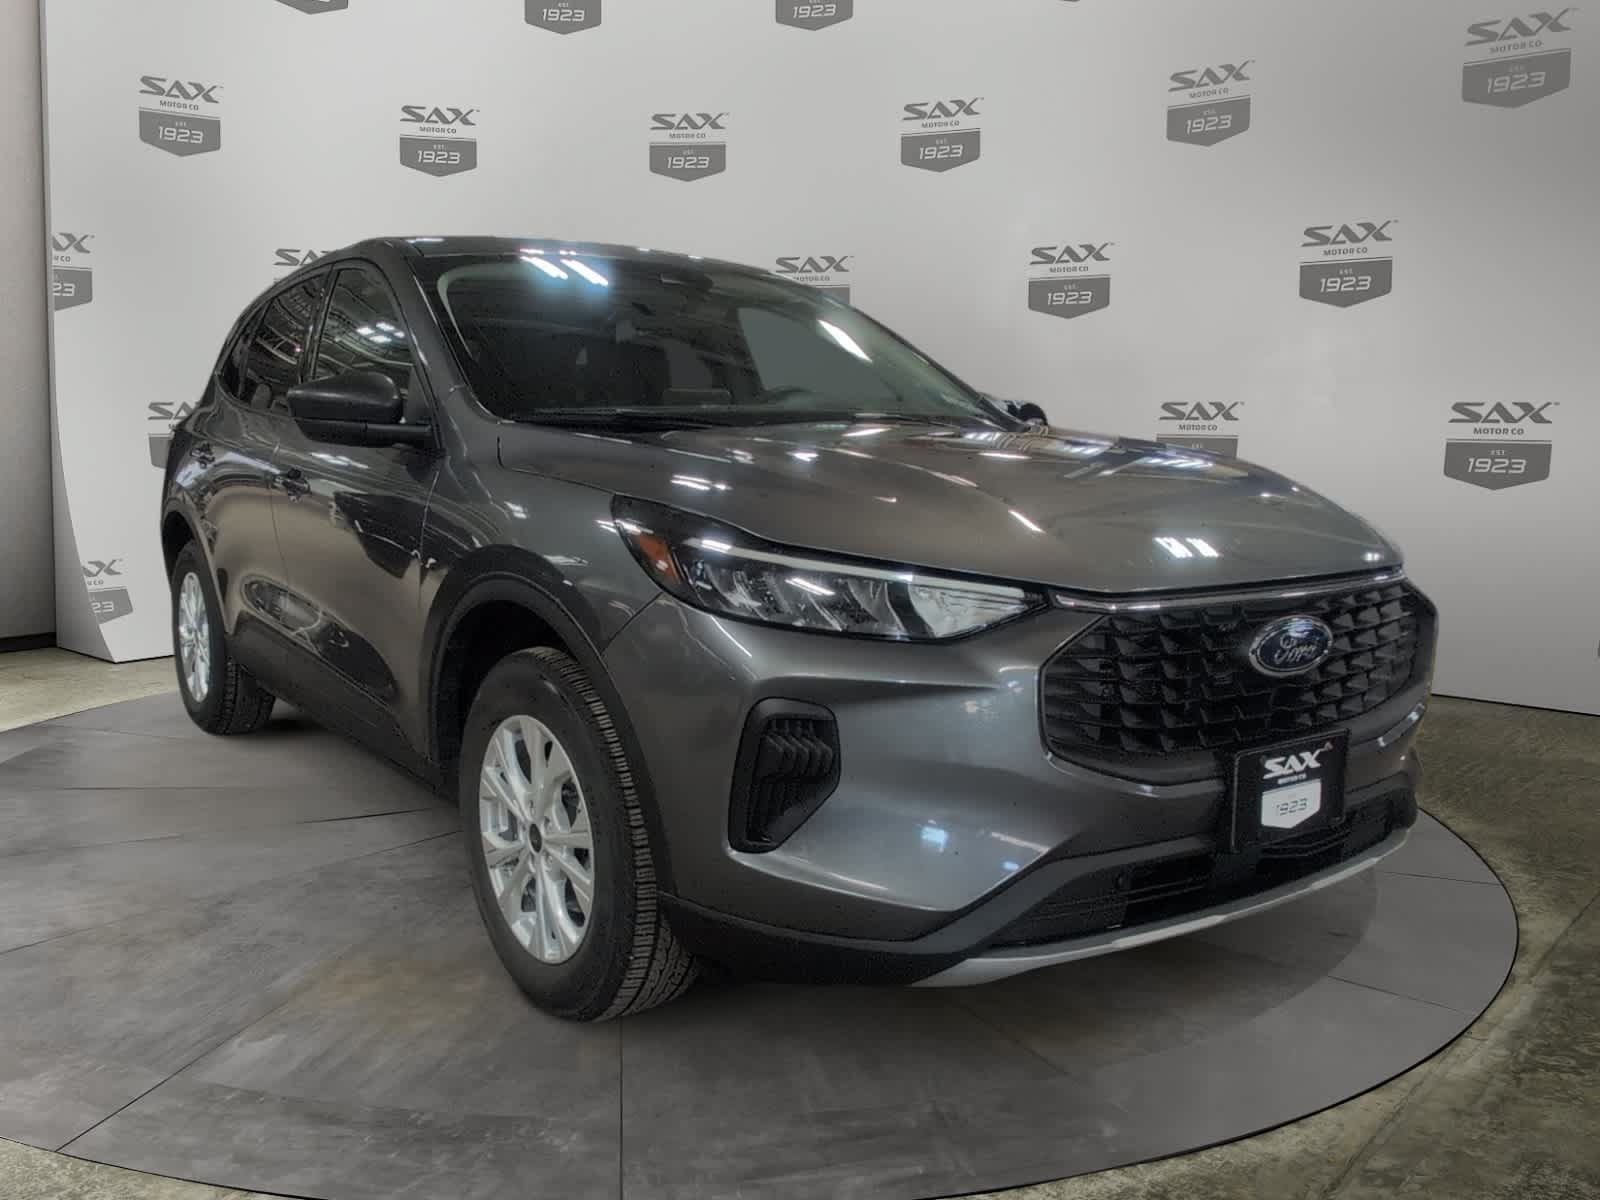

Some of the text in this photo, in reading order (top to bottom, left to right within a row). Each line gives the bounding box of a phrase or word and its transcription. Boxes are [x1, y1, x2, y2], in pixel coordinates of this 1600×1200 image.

[543, 8, 585, 22] 1923
[793, 4, 836, 18] 1923
[1464, 8, 1572, 47] SAX
[1168, 60, 1250, 92] SAX
[1487, 71, 1546, 94] 1923
[139, 75, 219, 104] SAX
[399, 105, 476, 126] SAX
[902, 97, 982, 121] SAX
[650, 112, 726, 131] SAX
[1185, 114, 1232, 135] 1923
[159, 126, 204, 144] 1923
[417, 150, 460, 164] 1923
[919, 144, 963, 160] 1923
[666, 156, 710, 169] 1923
[1301, 220, 1393, 247] SAX
[273, 248, 329, 267] SA
[1029, 242, 1111, 266] SAX
[1323, 246, 1368, 256] MOTOR CO
[775, 255, 849, 273] SAX
[52, 282, 75, 297] 23
[1319, 275, 1372, 293] 1923
[1047, 290, 1092, 305] 1923
[147, 401, 193, 420] SA
[1158, 401, 1239, 421] SAX
[1447, 401, 1553, 424] SAX
[1473, 427, 1525, 436] MOTOR CO
[1467, 457, 1527, 474] 1923
[90, 601, 114, 613] 23
[1262, 751, 1322, 780] SAX
